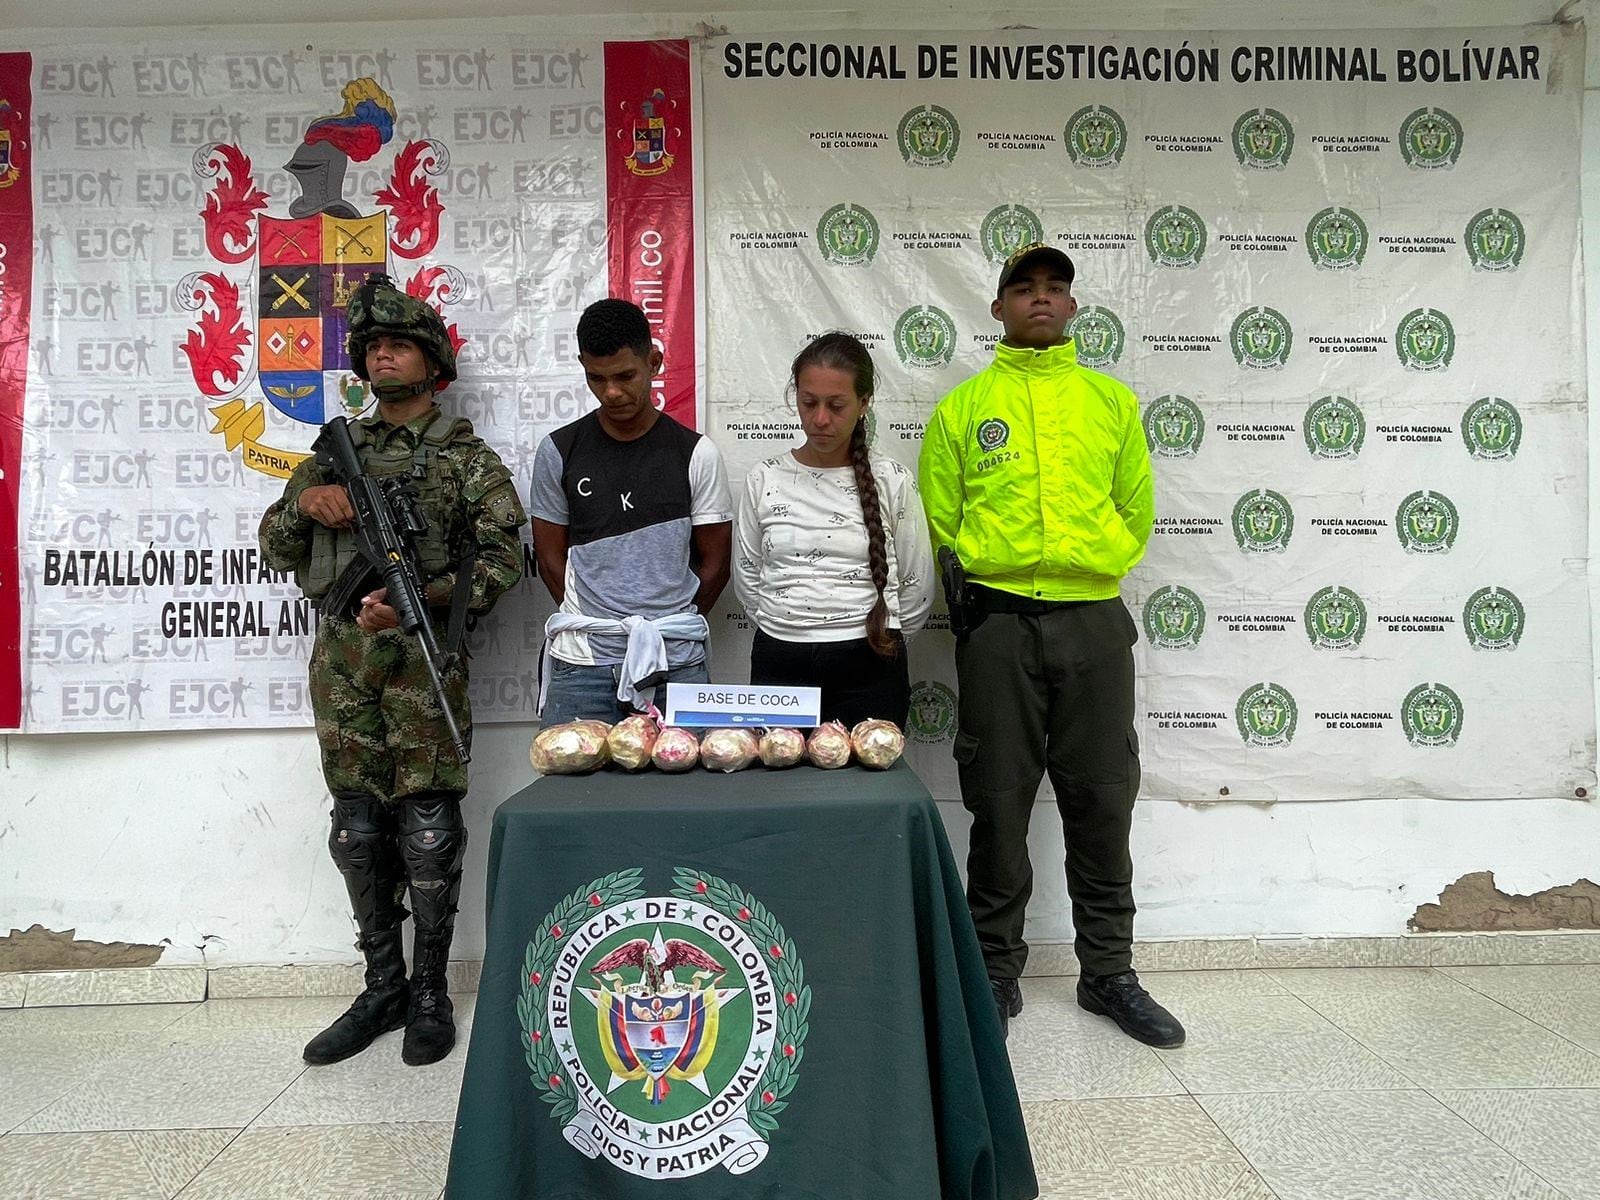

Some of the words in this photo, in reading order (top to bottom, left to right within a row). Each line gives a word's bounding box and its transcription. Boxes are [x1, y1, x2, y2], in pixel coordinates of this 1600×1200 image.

[724, 42, 906, 79] SECCIONAL
[918, 44, 958, 79] DE
[970, 41, 1219, 82] INVESTIGACIÓN
[1231, 46, 1386, 83] CRIMINAL
[1398, 40, 1540, 82] BOLÍVAR
[416, 53, 474, 87] EJC
[511, 54, 569, 84] EJC
[454, 113, 510, 142] EJC
[809, 130, 844, 140] POLICÍA
[845, 131, 889, 140] NACIONAL
[977, 131, 1011, 142] POLICÍA
[1012, 132, 1057, 142] NACIONAL
[1144, 134, 1178, 144] POLICÍA
[1179, 135, 1224, 144] NACIONAL
[1311, 134, 1346, 144] POLICÍA
[1347, 135, 1391, 144] NACIONAL
[820, 140, 832, 149] DE
[833, 140, 879, 149] COLOMBIA
[988, 142, 1000, 150] DE
[1001, 142, 1046, 150] COLOMBIA
[1155, 144, 1167, 152] DE
[1168, 144, 1213, 152] COLOMBIA
[1322, 144, 1334, 153] DE
[1335, 144, 1380, 153] COLOMBIA
[730, 230, 764, 240] POLICÍA
[765, 231, 809, 240] NACIONAL
[892, 231, 927, 241] POLICÍA
[928, 232, 973, 241] NACIONAL
[1057, 232, 1092, 241] POLICÍA
[1093, 233, 1137, 241] NACIONAL
[1219, 233, 1253, 243] POLICÍA
[1255, 234, 1298, 243] NACIONAL
[1378, 235, 1412, 245] POLICÍA
[1413, 236, 1457, 245] NACIONAL
[740, 241, 752, 249] DE
[753, 241, 799, 249] COLOMBIA
[903, 241, 915, 250] DE
[916, 241, 962, 250] COLOMBIA
[1068, 242, 1080, 250] DE
[1081, 242, 1127, 250] COLOMBIA
[1230, 243, 1242, 252] DE
[1243, 243, 1288, 252] COLOMBIA
[1142, 334, 1177, 343] POLICÍA
[1178, 335, 1222, 343] NACIONAL
[1308, 335, 1342, 344] POLICÍA
[1343, 336, 1388, 344] NACIONAL
[984, 343, 996, 351] DE
[1153, 344, 1165, 352] DE
[1166, 344, 1212, 352] COLOMBIA
[1319, 345, 1331, 353] DE
[1332, 345, 1378, 353] COLOMBIA
[726, 422, 760, 431] POLICÍA
[1216, 423, 1251, 432] POLICÍA
[1251, 424, 1296, 432] NACIONAL
[1375, 424, 1410, 434] POLICÍA
[1411, 425, 1453, 434] NACIONAL
[737, 432, 749, 440] DE
[750, 432, 795, 440] COLOMBIA
[900, 432, 912, 440] DE
[1227, 433, 1239, 441] DE
[1240, 433, 1286, 441] COLOMBIA
[1386, 434, 1398, 443] DE
[1399, 434, 1443, 443] COLOMBIA
[248, 448, 292, 472] PATRIA
[577, 477, 593, 497] C
[620, 491, 634, 511] K
[1153, 518, 1178, 526] LICÍA
[1179, 518, 1224, 526] NACIONAL
[1311, 517, 1344, 527] POLICÍA
[1345, 518, 1388, 527] NACIONAL
[1154, 527, 1166, 535] DE
[1167, 527, 1213, 535] COLOMBIA
[1321, 527, 1332, 536] DE
[1334, 527, 1378, 536] COLOMBIA
[44, 541, 174, 587] BATALLÓN
[184, 549, 213, 586] DE
[162, 600, 270, 638] GENERAL
[1217, 614, 1252, 623] POLICÍA
[1253, 615, 1297, 623] NACIONAL
[1377, 614, 1411, 623] POLICÍA
[1412, 615, 1456, 623] NACIONAL
[737, 622, 749, 630] DE
[1228, 624, 1241, 632] DE
[1242, 624, 1286, 632] COLOMBIA
[1387, 624, 1400, 633] DE
[1401, 624, 1445, 633] COLOMBIA
[169, 684, 230, 713] EJC
[697, 692, 734, 705] BASE
[737, 693, 756, 705] DE
[760, 694, 800, 707] COCA
[1147, 710, 1182, 720] POLICÍA
[1183, 711, 1228, 720] NACIONAL
[1314, 711, 1349, 720] POLICÍA
[1350, 712, 1394, 720] NACIONAL
[1158, 721, 1170, 729] DE
[1171, 721, 1217, 729] COLOMBIA
[1326, 721, 1338, 729] DE
[1339, 721, 1383, 729] COLOMBIA
[553, 914, 620, 1029] REPÚBLICA
[645, 902, 678, 919] DE
[702, 914, 772, 1036] COLOMBIA
[566, 1059, 632, 1136] POLICÍA
[657, 1062, 763, 1144] NACIONAL
[656, 1133, 736, 1173] PATRIA
